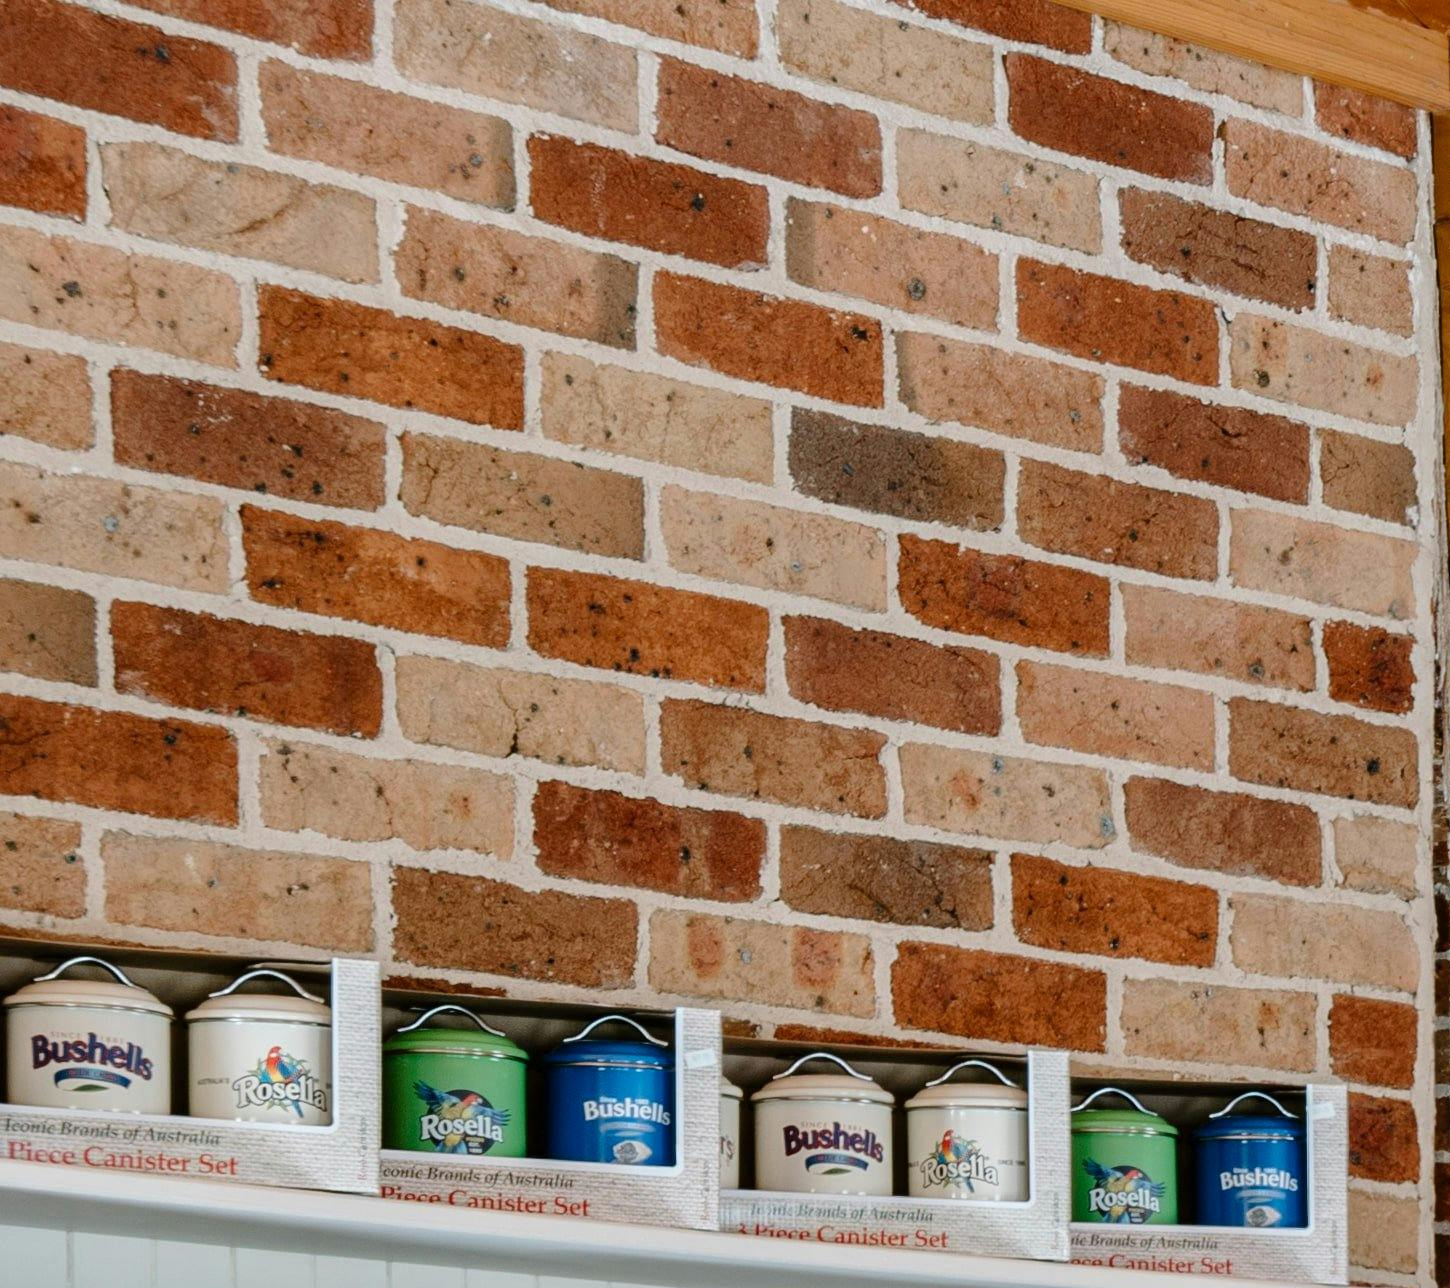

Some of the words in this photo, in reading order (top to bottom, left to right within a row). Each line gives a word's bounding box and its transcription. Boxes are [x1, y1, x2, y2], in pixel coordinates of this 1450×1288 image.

[31, 1032, 153, 1081] Bushells
[232, 1074, 328, 1112] Rosella
[583, 1097, 670, 1126] Bushells
[4, 1118, 59, 1135] Iconic
[60, 1121, 118, 1139] Brands
[123, 1126, 141, 1141] of
[145, 1127, 222, 1146] Australia
[421, 1114, 504, 1143] Rosella
[783, 1121, 883, 1163] Bushells
[8, 1141, 75, 1165] Piece
[84, 1145, 190, 1173] Canister
[198, 1154, 238, 1175] Set
[920, 1154, 999, 1189] Rosella
[381, 1165, 423, 1179] conic
[425, 1166, 481, 1183] Brands
[484, 1170, 500, 1187] of
[503, 1170, 575, 1189] Australia
[1220, 1167, 1298, 1192] Bushells
[449, 1189, 546, 1214] Canister
[553, 1198, 590, 1217] Set
[797, 1204, 848, 1219] Brands
[851, 1206, 864, 1221] of
[870, 1206, 934, 1222] Australia
[1089, 1187, 1160, 1213] Rosella
[818, 1225, 908, 1247] Canister
[914, 1229, 948, 1249] Set
[1088, 1234, 1136, 1247] Brands
[1140, 1236, 1154, 1251] of
[1156, 1236, 1218, 1250] Australia
[1109, 1254, 1194, 1274] Canister
[1201, 1258, 1233, 1275] Set
